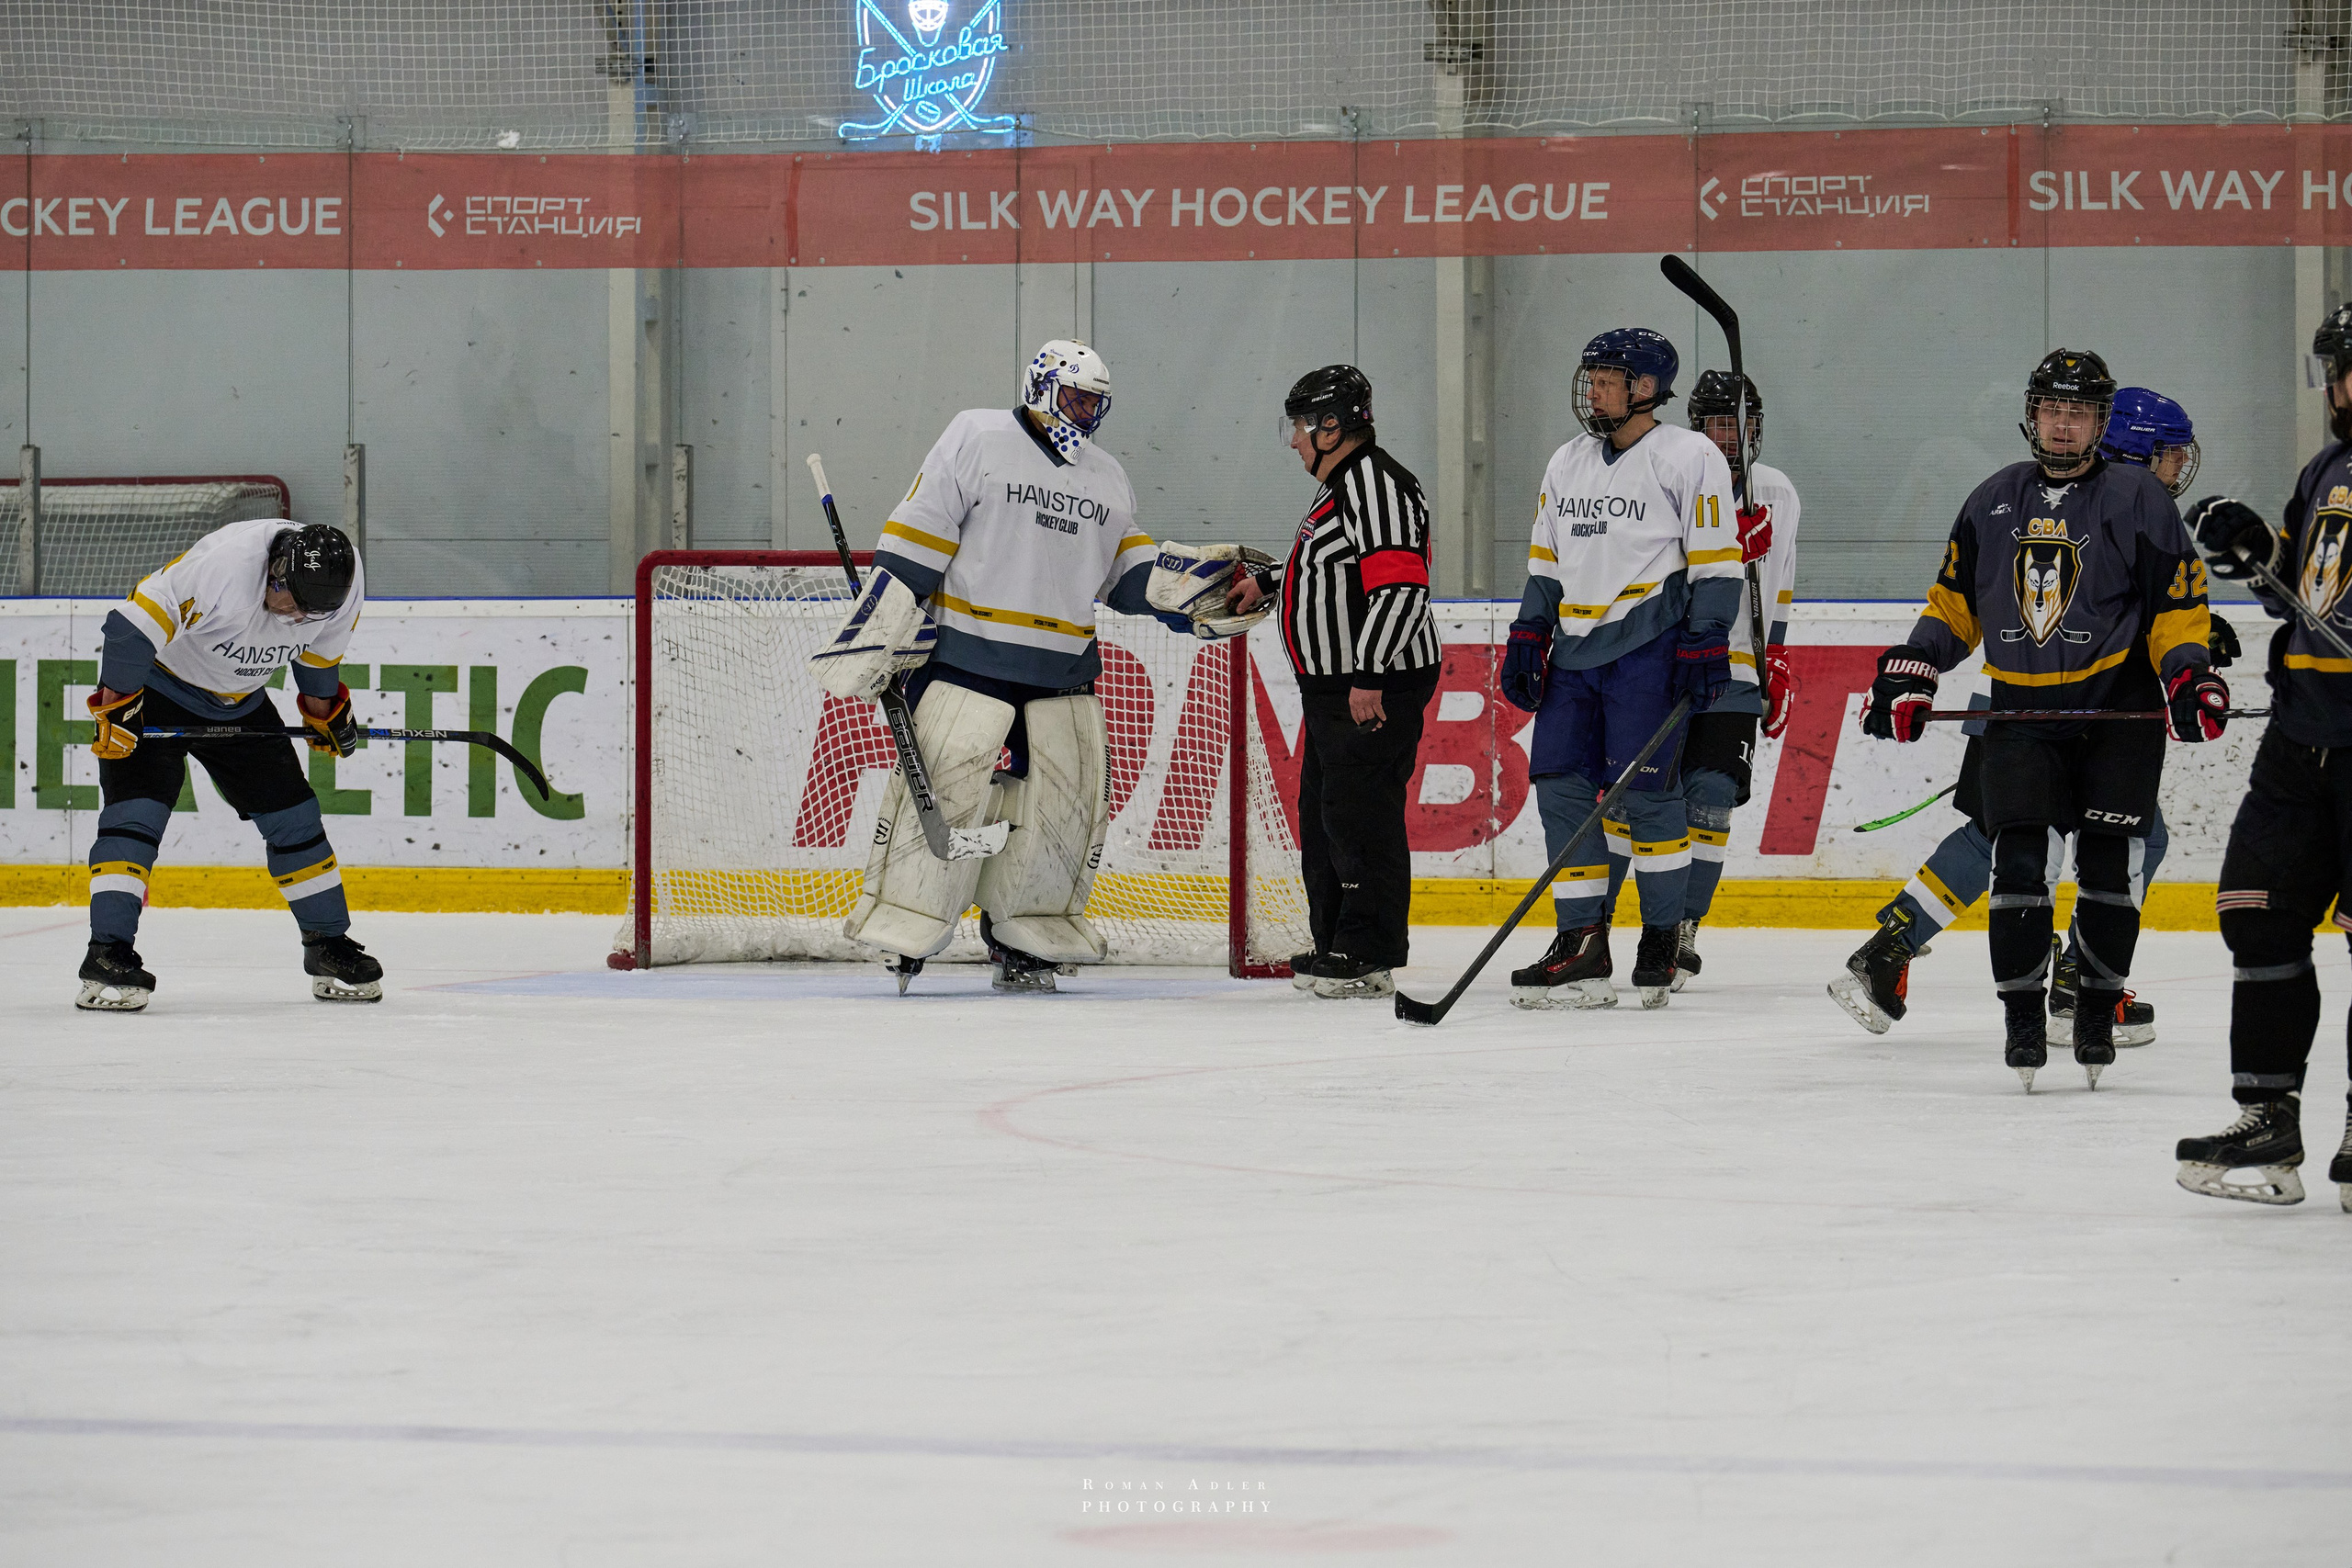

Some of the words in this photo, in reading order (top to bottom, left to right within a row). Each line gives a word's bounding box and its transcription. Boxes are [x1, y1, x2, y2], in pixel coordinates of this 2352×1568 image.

[855, 26, 1009, 93] Бросковая
[903, 73, 978, 102] Школа
[1741, 175, 1872, 196] СПОРТ
[2029, 171, 2145, 211] SILK
[2159, 170, 2285, 209] WAY
[2302, 169, 2352, 210] H
[145, 197, 342, 236] LEAGUE
[466, 196, 591, 214] СПОРТ
[910, 191, 1023, 231] SILK
[1037, 189, 1155, 229] WAY
[1170, 186, 1388, 227] HOCKEY
[1404, 182, 1611, 223] LEAGUE
[1741, 194, 1929, 217] СТАНЦИЯ
[466, 216, 642, 238] СТАНЦИЯ
[1638, 332, 1665, 341] CCM
[2052, 381, 2080, 391] Reebok
[2122, 453, 2143, 461] BAUER
[1007, 482, 1110, 526] HANSTON
[1696, 494, 1720, 527] 11
[1058, 517, 1079, 535] CLUB
[2167, 558, 2209, 600] 32
[1753, 582, 1763, 611] BAUER
[206, 725, 242, 733] BAUER
[390, 728, 448, 739] NEXUS
[888, 707, 934, 814] BAUER
[2085, 808, 2143, 826] CCM
